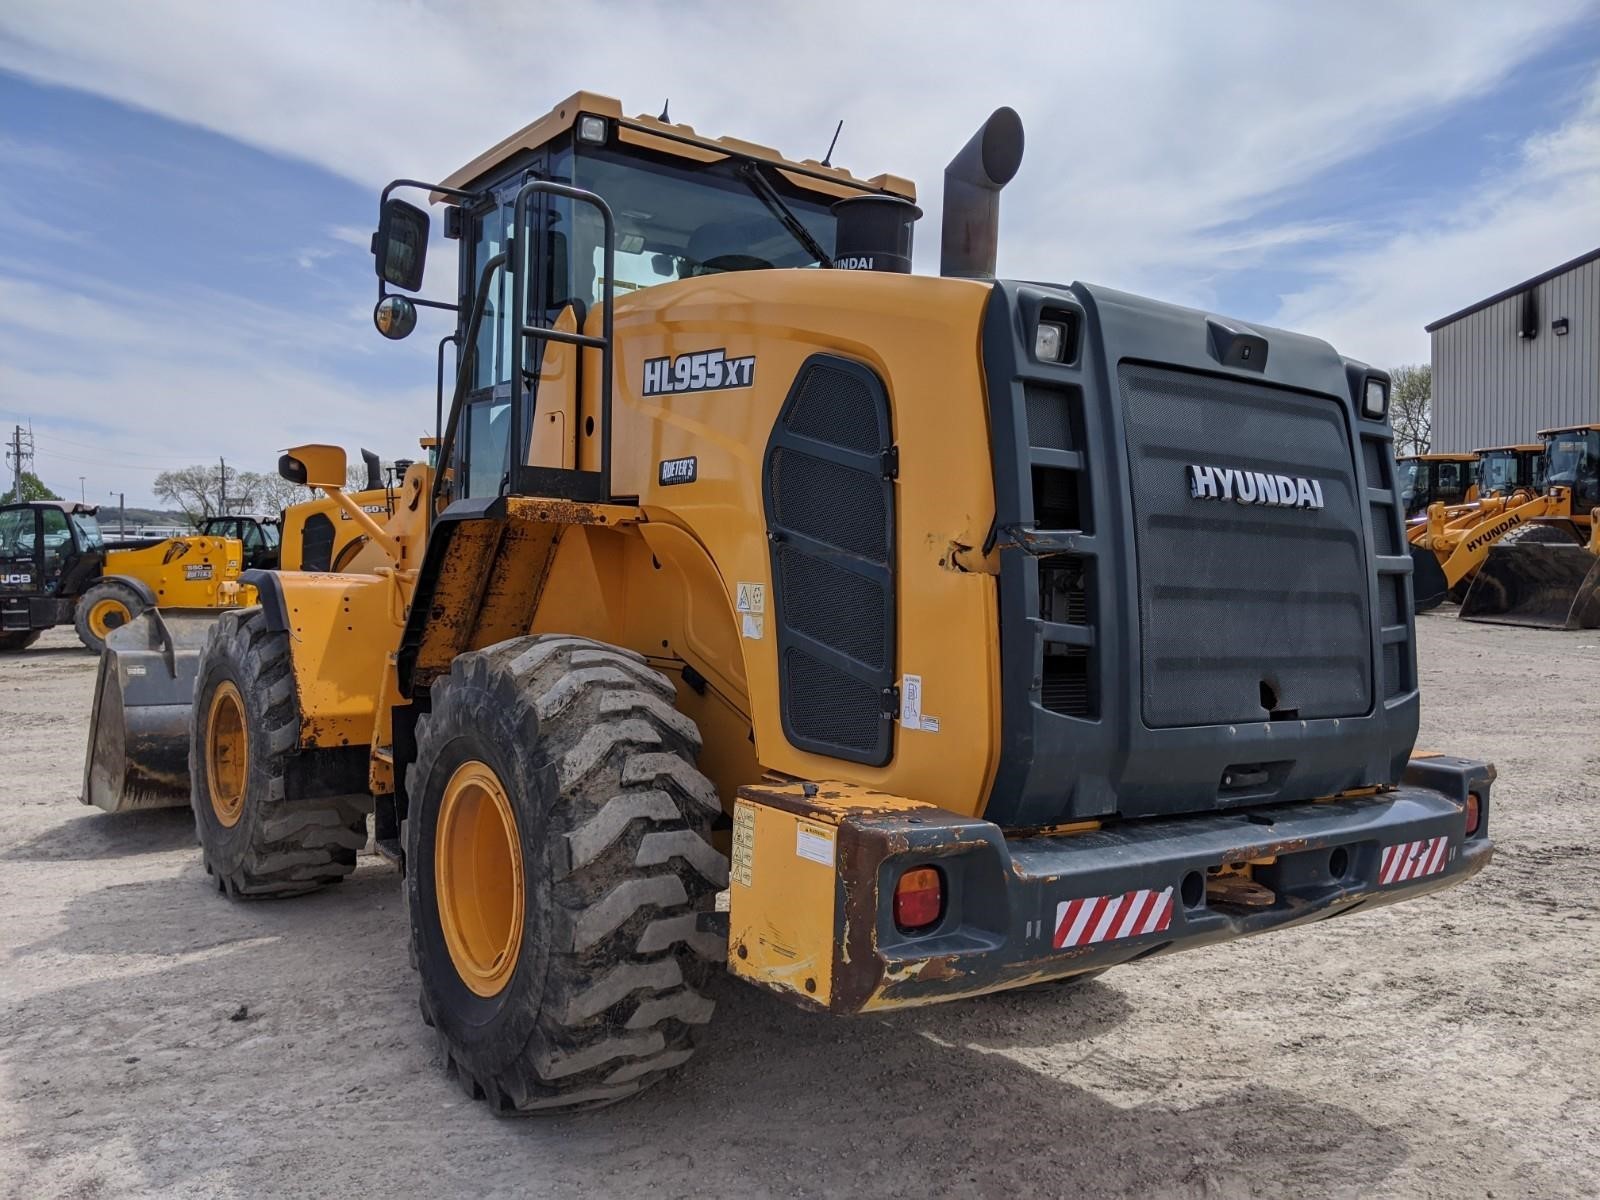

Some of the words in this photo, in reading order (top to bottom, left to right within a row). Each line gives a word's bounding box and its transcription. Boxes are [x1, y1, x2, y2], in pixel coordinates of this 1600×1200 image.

[833, 257, 874, 270] UNDAI
[643, 351, 755, 394] HL955XT
[1191, 465, 1324, 510] HYUNDAI
[1466, 513, 1522, 553] HYUNDAI
[0, 574, 31, 584] JCB
